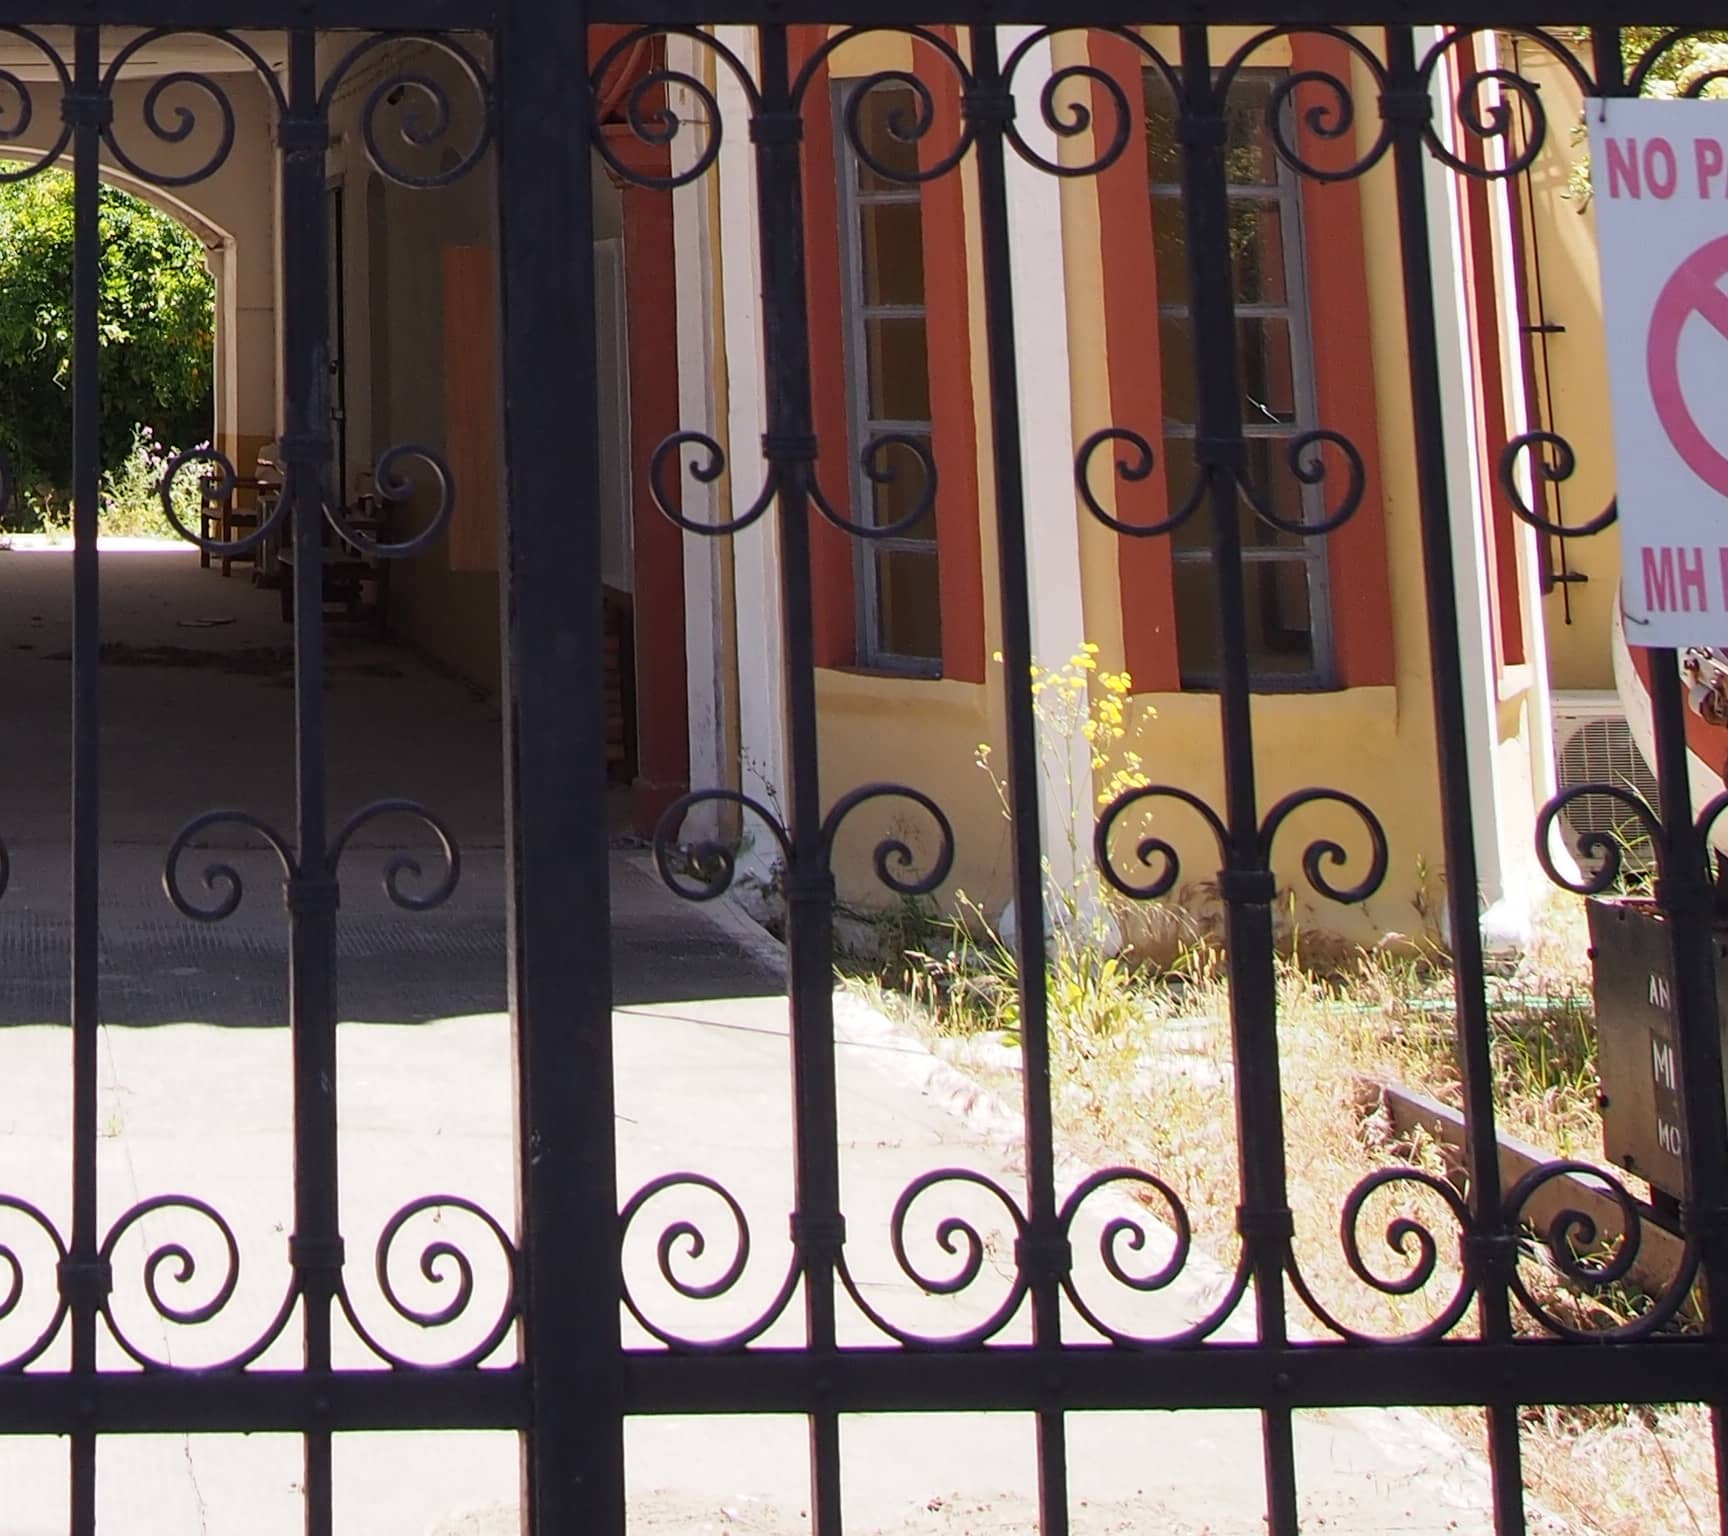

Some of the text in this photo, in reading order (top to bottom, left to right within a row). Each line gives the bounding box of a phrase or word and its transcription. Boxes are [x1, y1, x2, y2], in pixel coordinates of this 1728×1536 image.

[1604, 136, 1728, 200] NO P
[1641, 546, 1709, 613] ΜΗ
